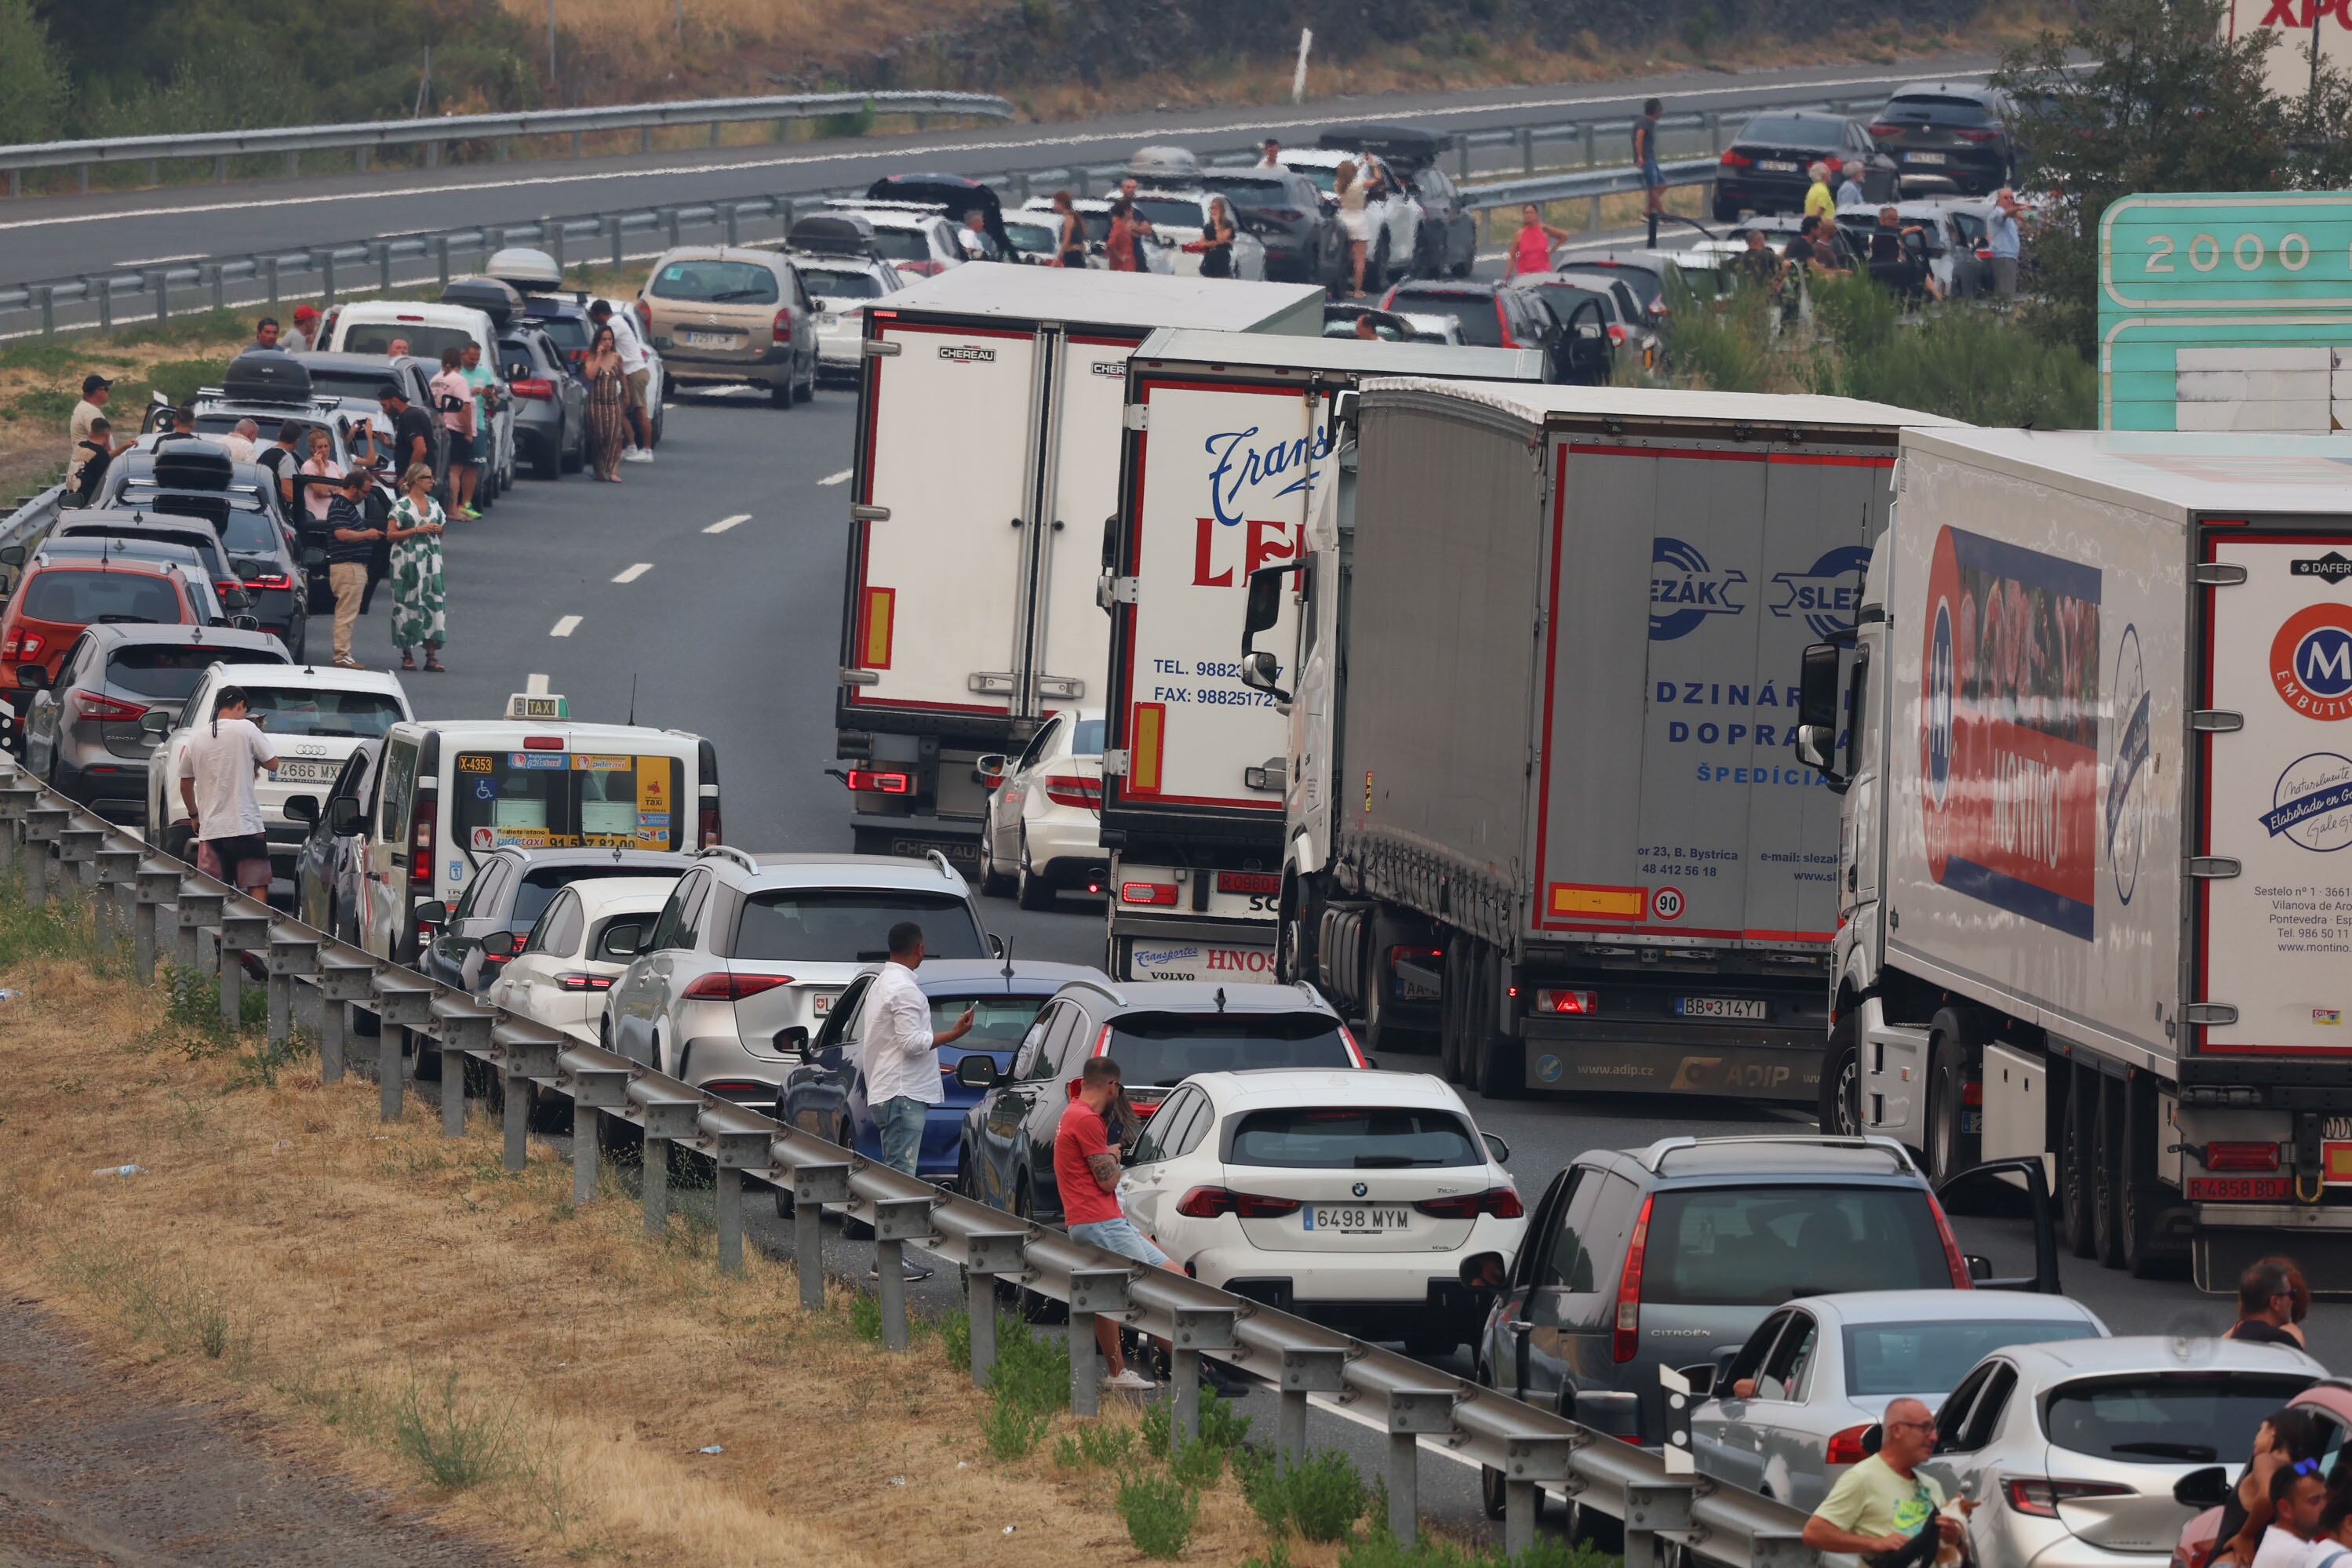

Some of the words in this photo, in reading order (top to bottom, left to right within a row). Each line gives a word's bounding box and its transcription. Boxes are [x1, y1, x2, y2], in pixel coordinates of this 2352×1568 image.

[2146, 233, 2310, 273] 2000
[941, 350, 993, 361] CHEREAU
[1154, 659, 1189, 675] TEL.
[2306, 642, 2352, 679] M
[1155, 686, 1192, 703] FAX:
[1197, 689, 1278, 708] 98825172
[529, 700, 555, 715] TAXI
[280, 764, 315, 777] 4666
[461, 757, 491, 771] X-4353
[2270, 798, 2325, 830] Elaborado
[2326, 795, 2339, 806] en
[1653, 846, 1670, 859] 23,
[1674, 848, 1686, 857] B.
[1690, 848, 1738, 861] Bystrica
[1760, 852, 1800, 863] e-mail:
[1660, 864, 1681, 875] 412
[1685, 865, 1699, 876] 56
[1702, 866, 1717, 877] 18
[2255, 886, 2292, 897] Sestelo
[2310, 887, 2315, 897] 1
[2325, 887, 2352, 897] 3661
[1659, 896, 1677, 911] 90
[2273, 900, 2316, 911] Vilanova
[2319, 901, 2332, 911] de
[2270, 914, 2327, 924] Pontevedra
[2277, 928, 2295, 937] Tel.
[2299, 929, 2317, 938] 986
[2321, 929, 2334, 938] 50
[2338, 930, 2348, 939] 11
[1134, 946, 1199, 967] Transportes
[1150, 971, 1195, 980] VOLVO
[1685, 998, 1705, 1014] BB
[1578, 1064, 1654, 1078] www.adip.cz
[1727, 1065, 1789, 1088] ADIP
[2208, 1181, 2250, 1196] 4858
[1318, 1210, 1365, 1227] 6498
[1373, 1210, 1407, 1228] MYM
